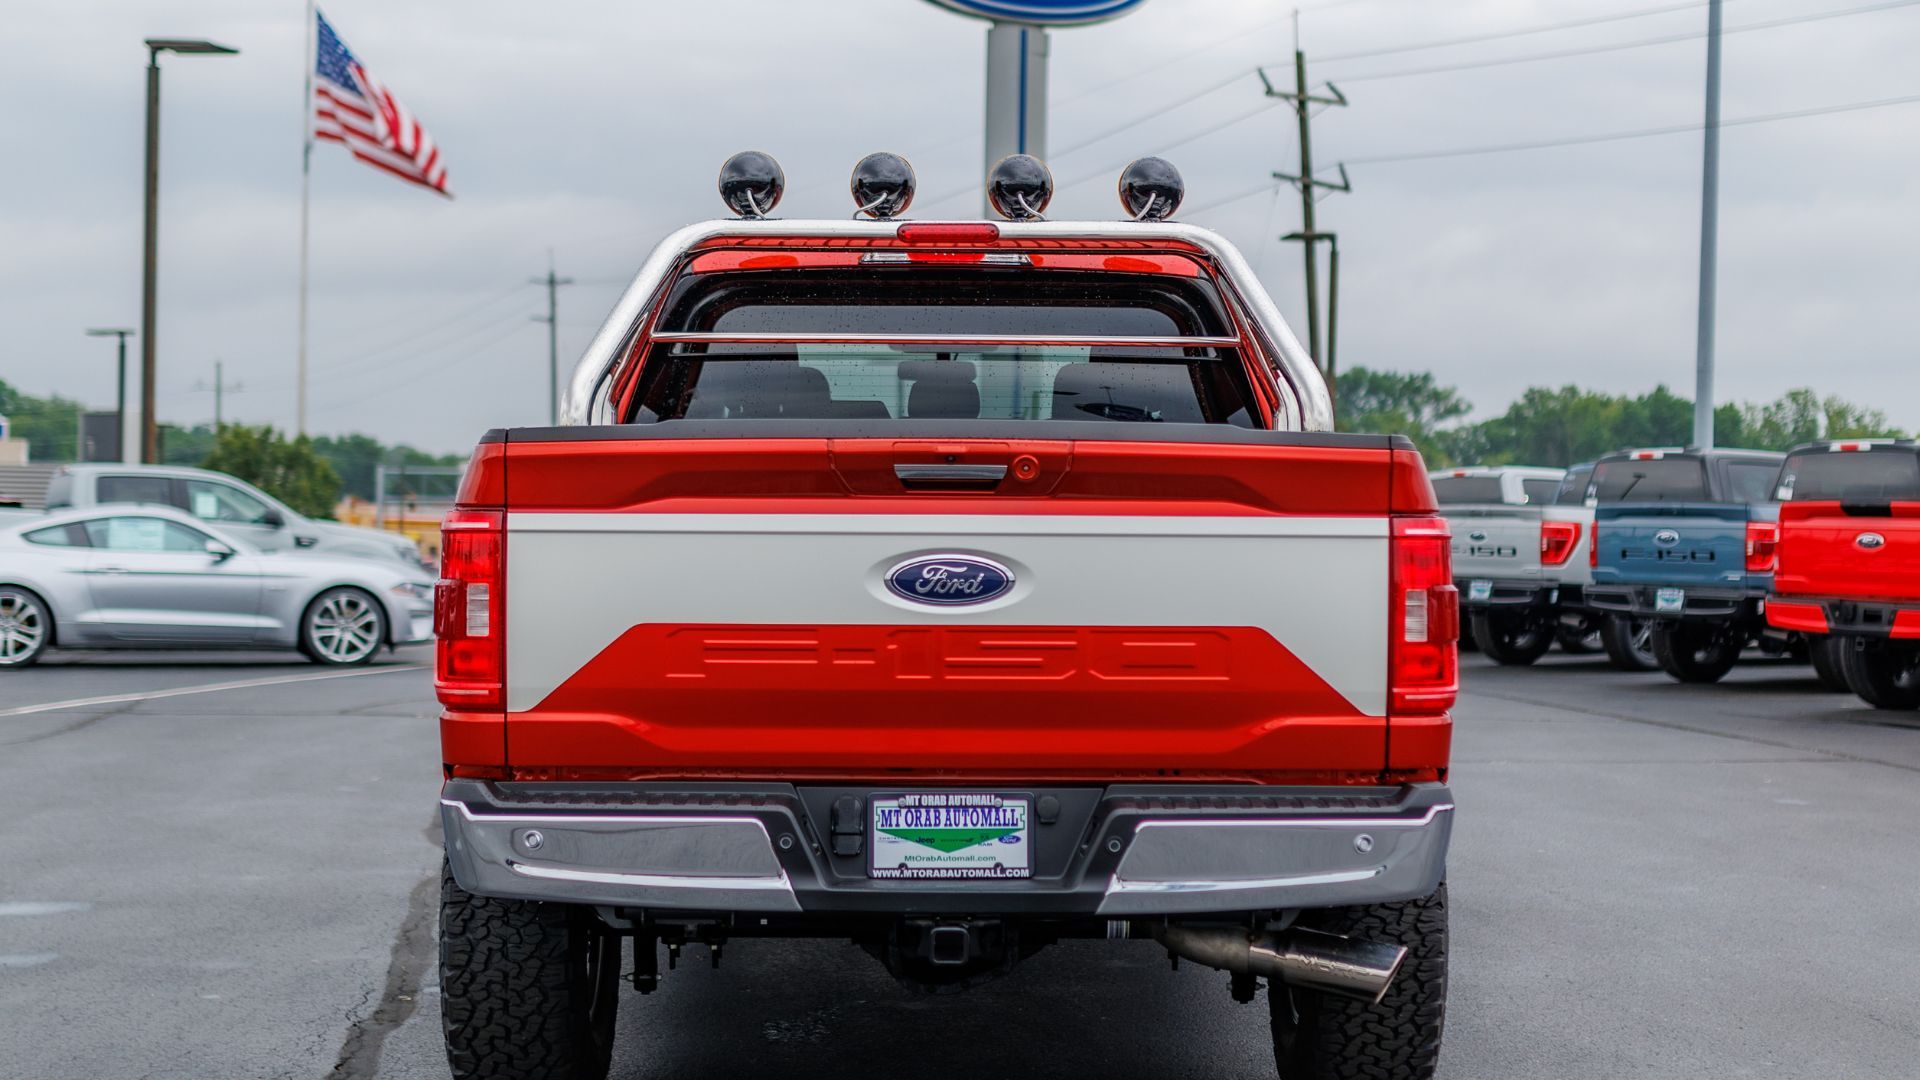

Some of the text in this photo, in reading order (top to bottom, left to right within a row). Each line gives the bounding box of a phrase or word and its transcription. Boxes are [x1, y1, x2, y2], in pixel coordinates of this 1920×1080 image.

[915, 564, 985, 594] Ford
[666, 628, 1230, 681] F-150
[905, 795, 919, 806] MT
[921, 795, 946, 806] ORAB
[880, 808, 1018, 828] MT ORAB AUTOMALL
[872, 869, 1030, 878] WWW.MTORABAUTOMALL.COM
